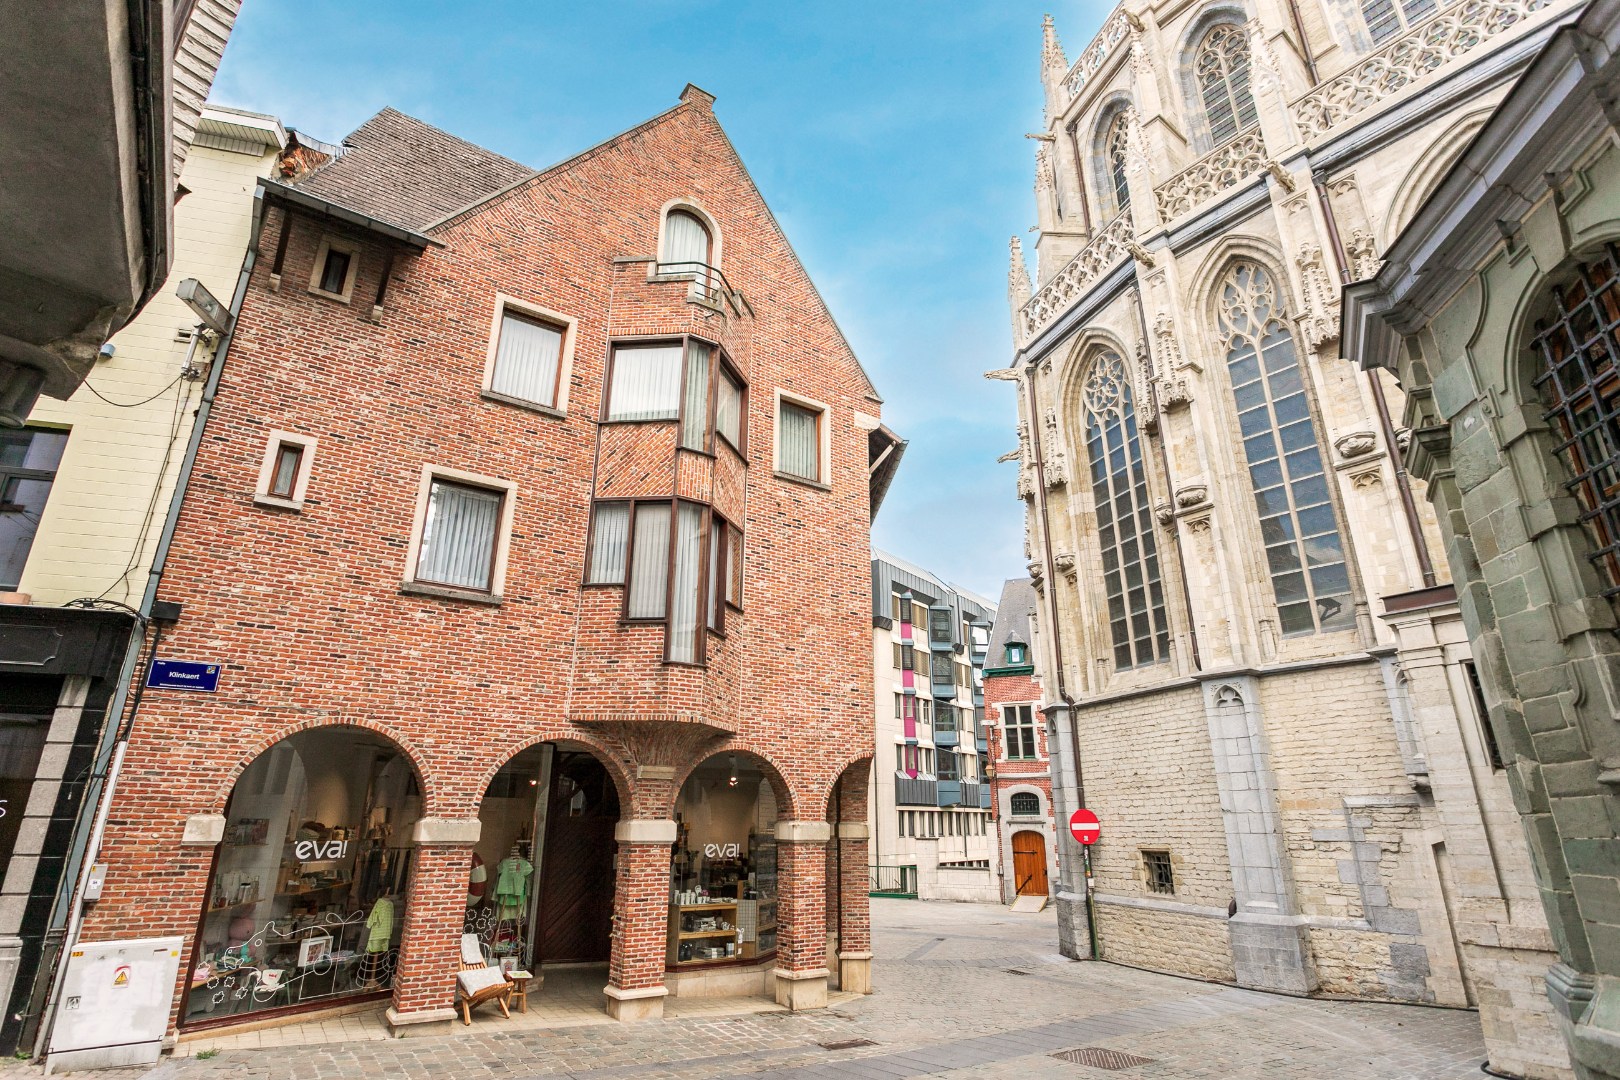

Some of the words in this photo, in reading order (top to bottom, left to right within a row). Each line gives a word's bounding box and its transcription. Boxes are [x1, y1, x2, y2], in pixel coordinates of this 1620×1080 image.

[169, 671, 200, 680] Klinkaert
[294, 840, 348, 860] eva!
[703, 843, 740, 858] eva!
